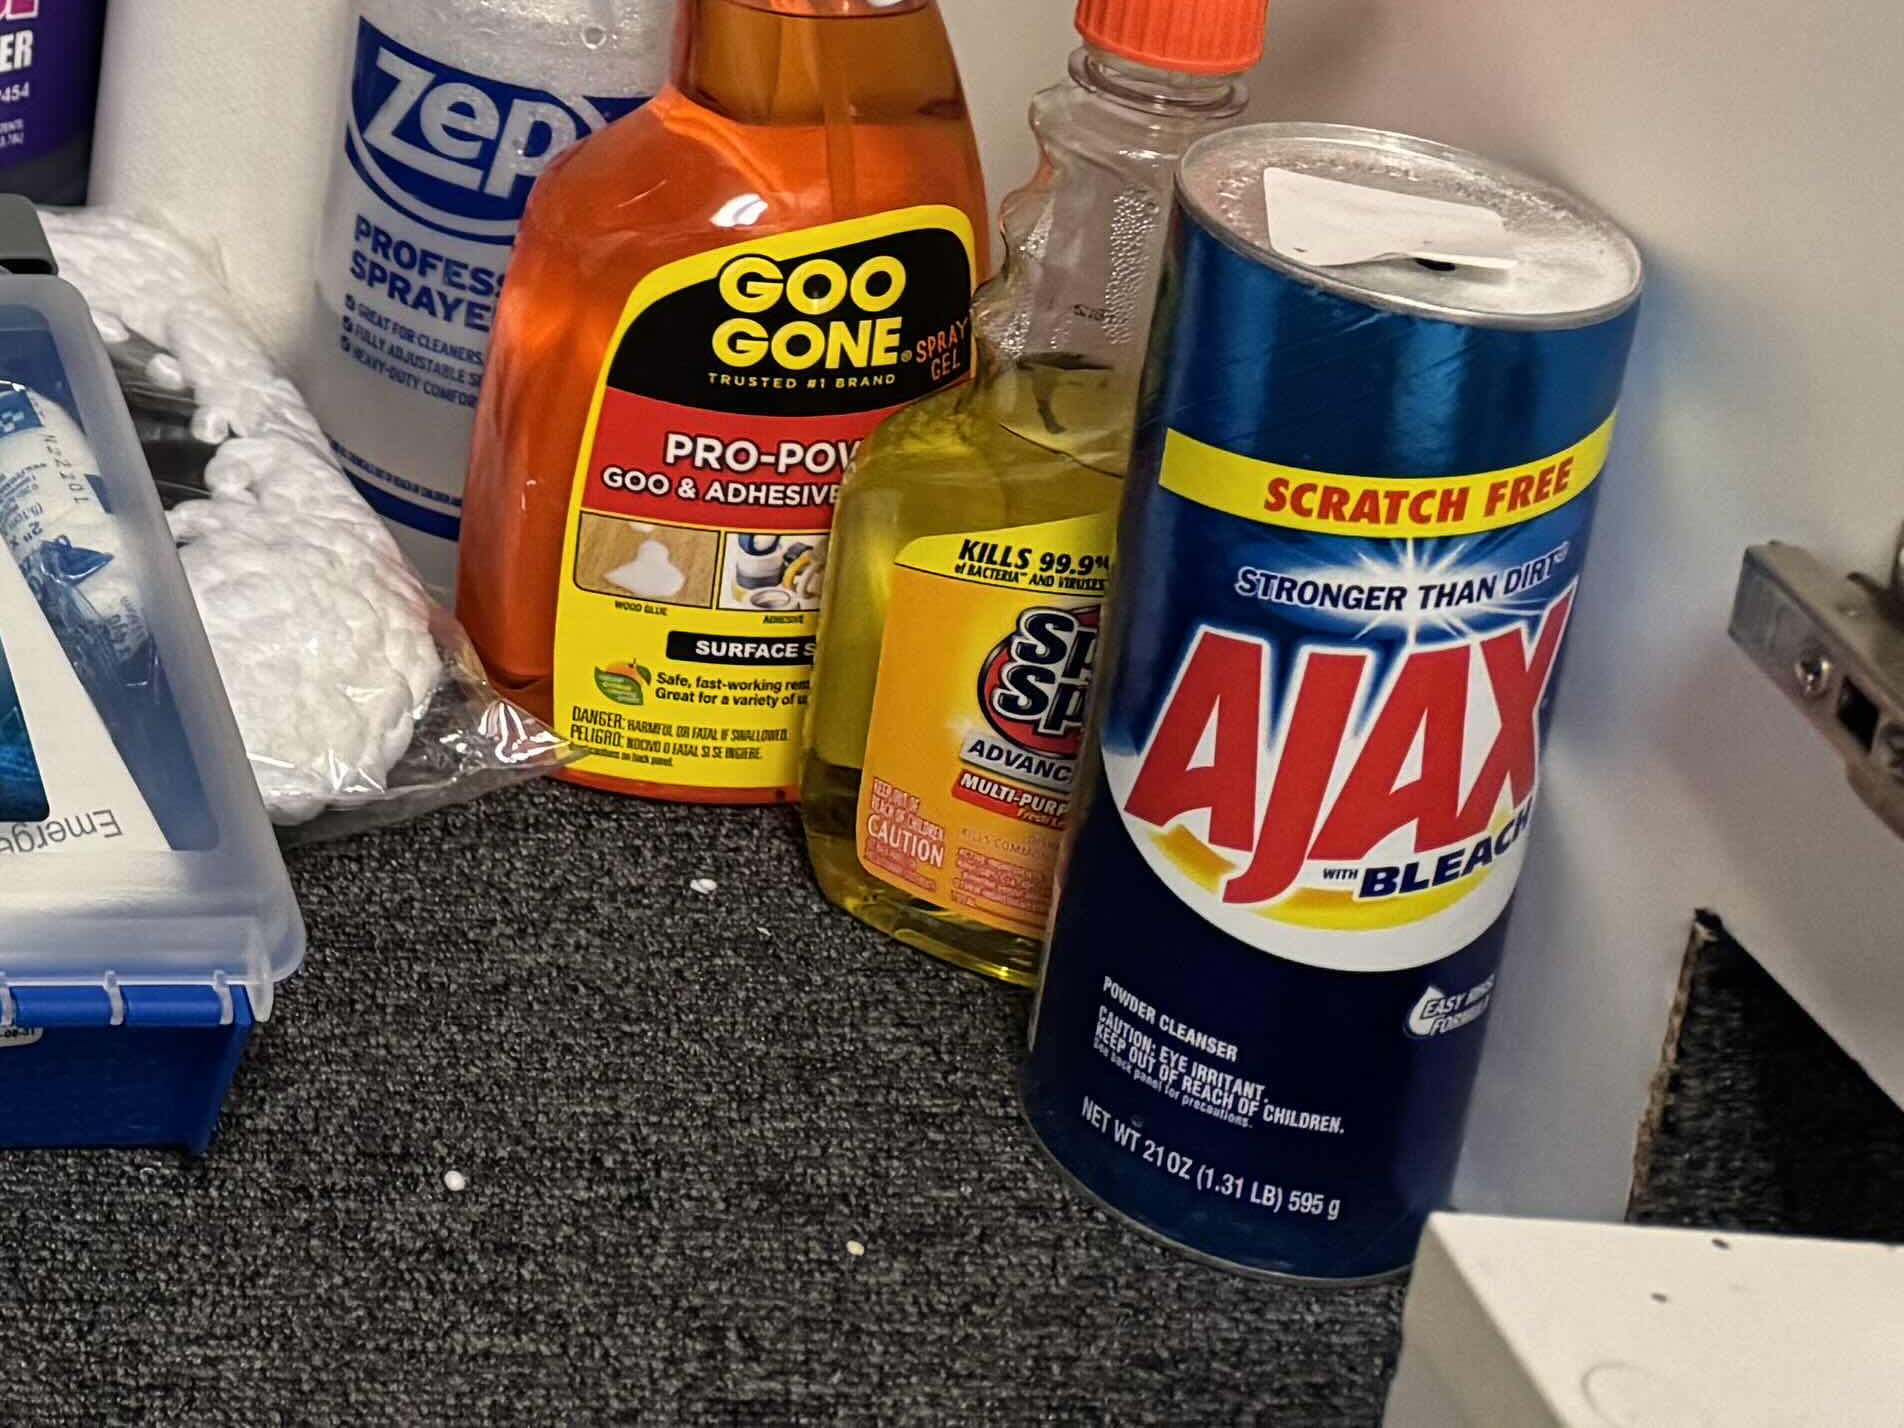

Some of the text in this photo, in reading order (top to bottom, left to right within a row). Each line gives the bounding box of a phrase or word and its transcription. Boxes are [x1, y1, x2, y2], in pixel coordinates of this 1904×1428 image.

[362, 47, 577, 198] Zep
[719, 255, 906, 315] GOO
[712, 316, 903, 370] GONE
[916, 318, 968, 364] SPRAY
[931, 353, 961, 382] GEL
[707, 373, 896, 389] TRUSTED #1 BRAND
[1263, 456, 1574, 525] SCRATCH FREE
[958, 538, 1032, 572] KILLS
[1235, 567, 1407, 612] STRONGER
[1418, 579, 1495, 611] THAN
[695, 640, 798, 658] SURFACE
[657, 672, 782, 692] Safe, fast-working
[1124, 581, 1577, 904] AJAX
[867, 812, 944, 867] CAUTION
[1323, 797, 1532, 900] WITH BLEACH
[1102, 975, 1238, 1062] POWDER CLEANSER
[1098, 1004, 1270, 1104] CAUTION: EYE IRRITANT.
[1080, 1096, 1341, 1220] NET WT 21 OZ (1.31 LB) 595 g
